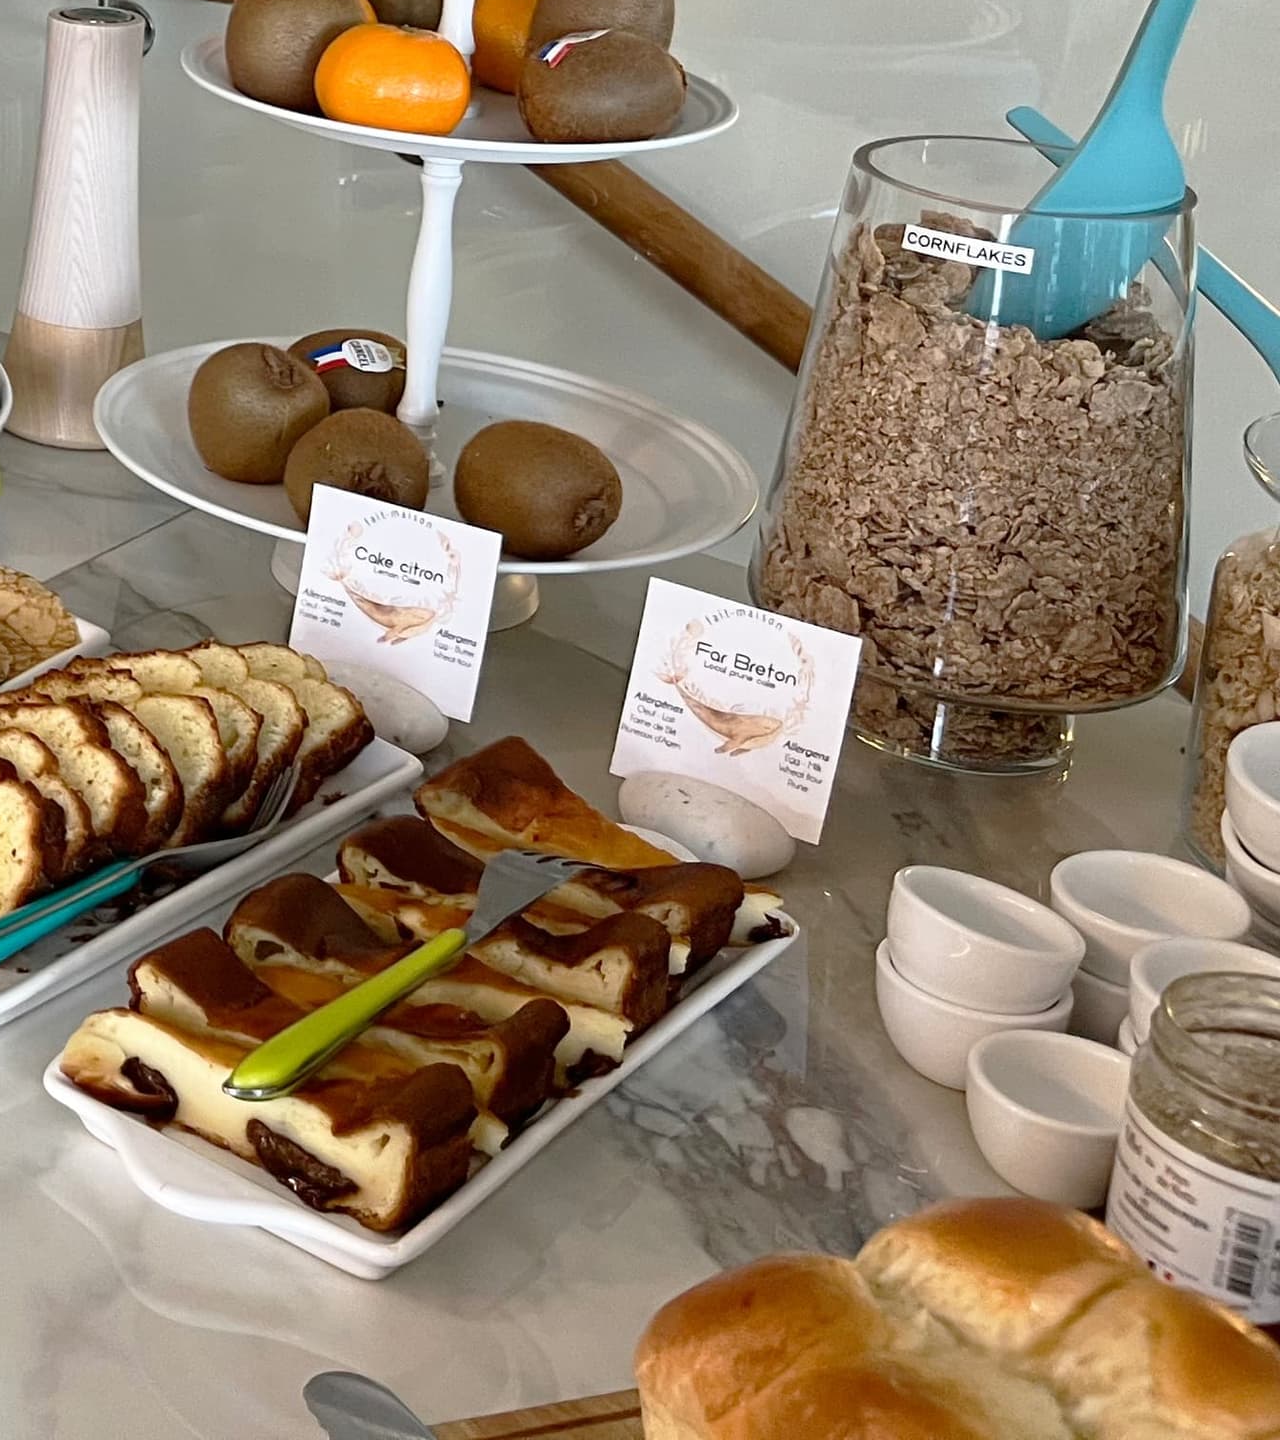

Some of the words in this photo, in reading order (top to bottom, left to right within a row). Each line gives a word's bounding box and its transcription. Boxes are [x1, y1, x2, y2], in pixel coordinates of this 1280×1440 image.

[907, 231, 1027, 268] CORNFLAKES
[364, 511, 433, 528] fait-maison
[355, 546, 393, 568] Cake
[400, 562, 444, 584] citron
[705, 608, 784, 631] fait-maison
[437, 628, 477, 648] Allergens
[696, 641, 727, 662] Far
[734, 653, 798, 686] Breton
[704, 660, 727, 675] Local
[729, 669, 753, 681] prune
[783, 740, 830, 763] Allergens
